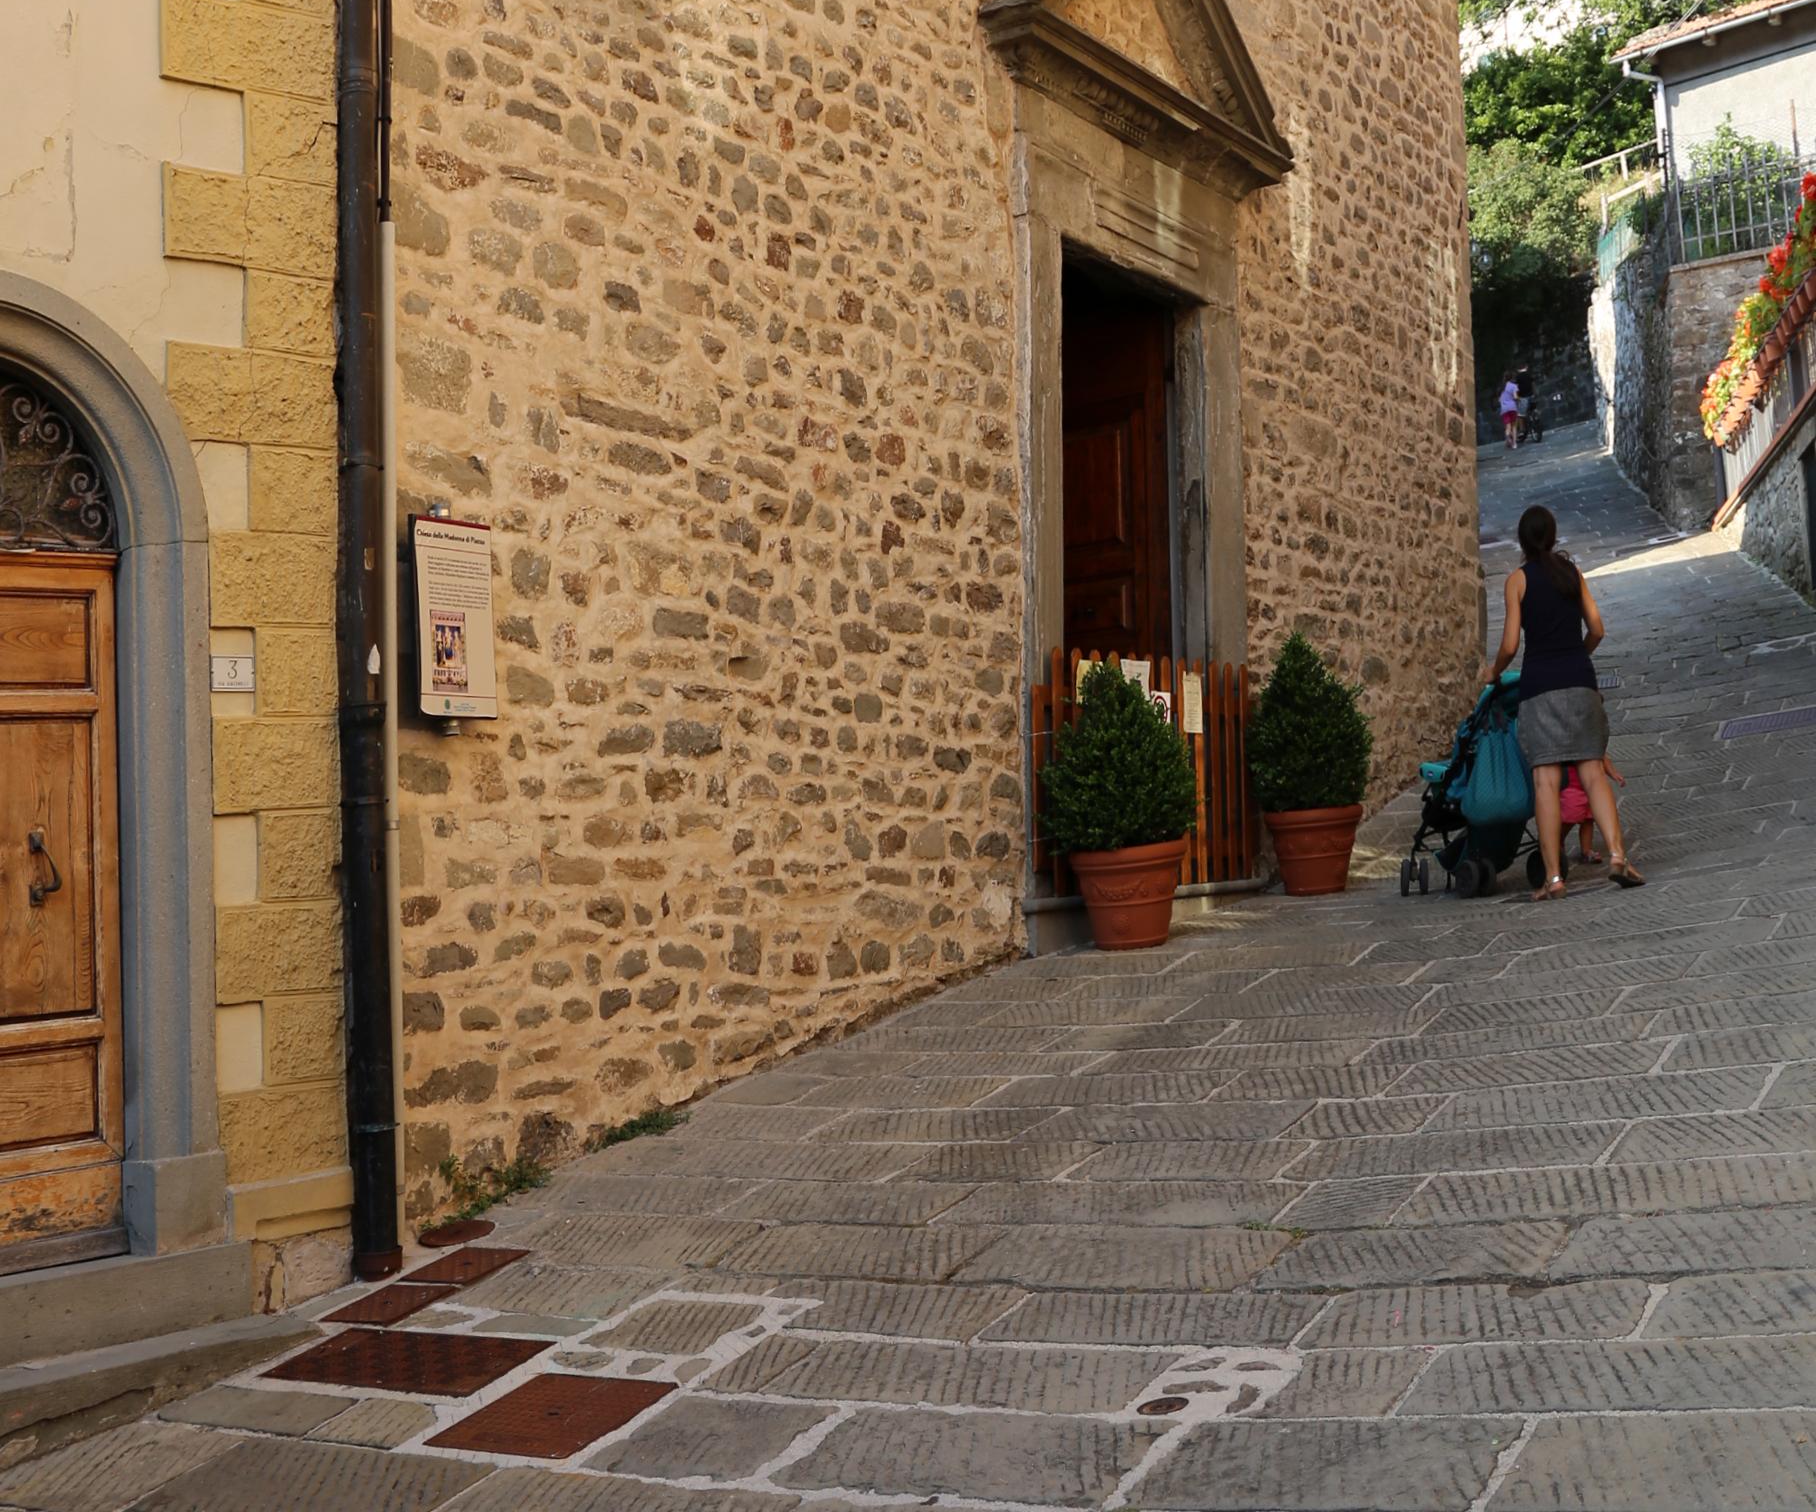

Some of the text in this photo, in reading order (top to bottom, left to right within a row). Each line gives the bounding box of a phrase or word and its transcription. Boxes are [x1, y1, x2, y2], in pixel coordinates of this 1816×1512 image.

[416, 529, 432, 538] Chiesa
[433, 531, 444, 539] della
[444, 533, 465, 542] Madonna
[470, 536, 485, 545] Piazza
[227, 660, 238, 680] 3
